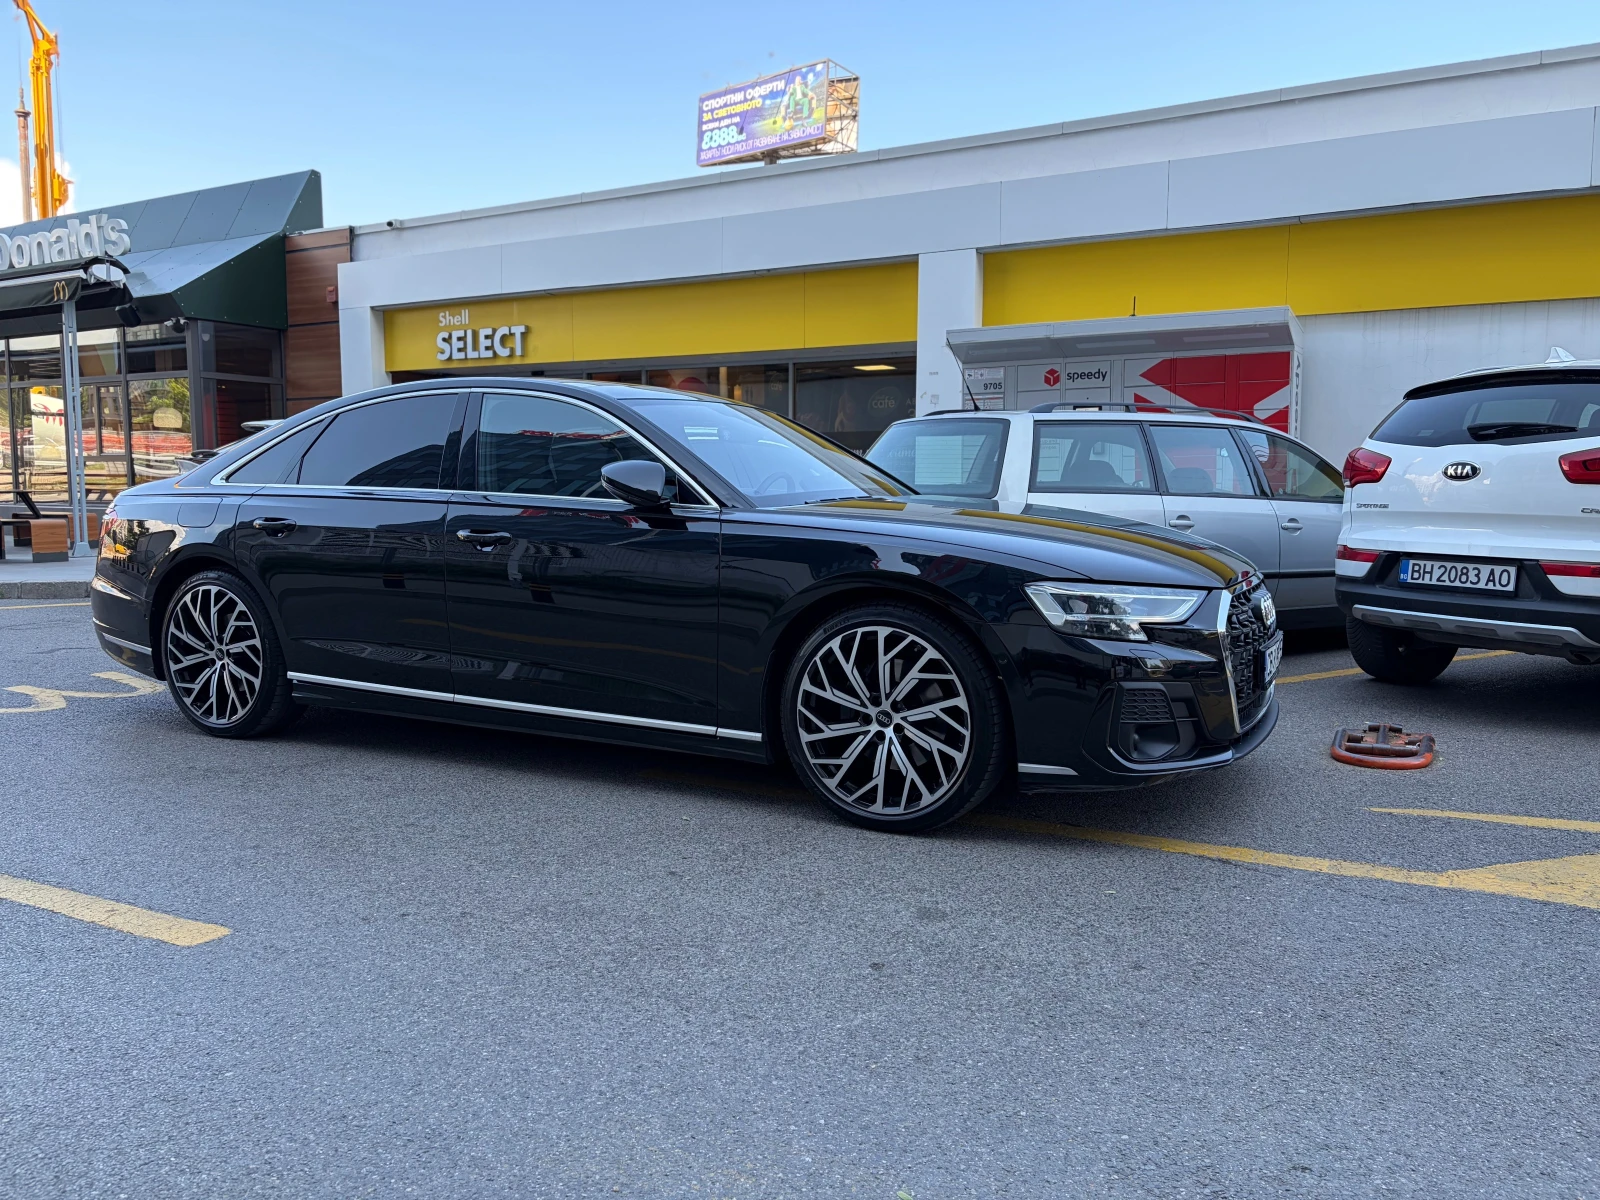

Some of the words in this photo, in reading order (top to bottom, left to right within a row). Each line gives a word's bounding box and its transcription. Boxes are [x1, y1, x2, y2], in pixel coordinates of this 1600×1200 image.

[702, 91, 744, 111] СПОРТНИ
[745, 79, 785, 99] ОФЕРТИ
[702, 112, 712, 122] ЗА
[713, 98, 762, 119] СВЕТОВНОТО
[439, 309, 469, 326] Shell
[436, 325, 527, 360] SELECT
[1066, 368, 1108, 382] speedy
[983, 382, 1003, 391] 9705
[872, 395, 895, 409] café
[1447, 464, 1474, 477] KIA
[1410, 563, 1435, 582] BH
[1436, 564, 1482, 587] 2083
[1484, 569, 1512, 588] AO
